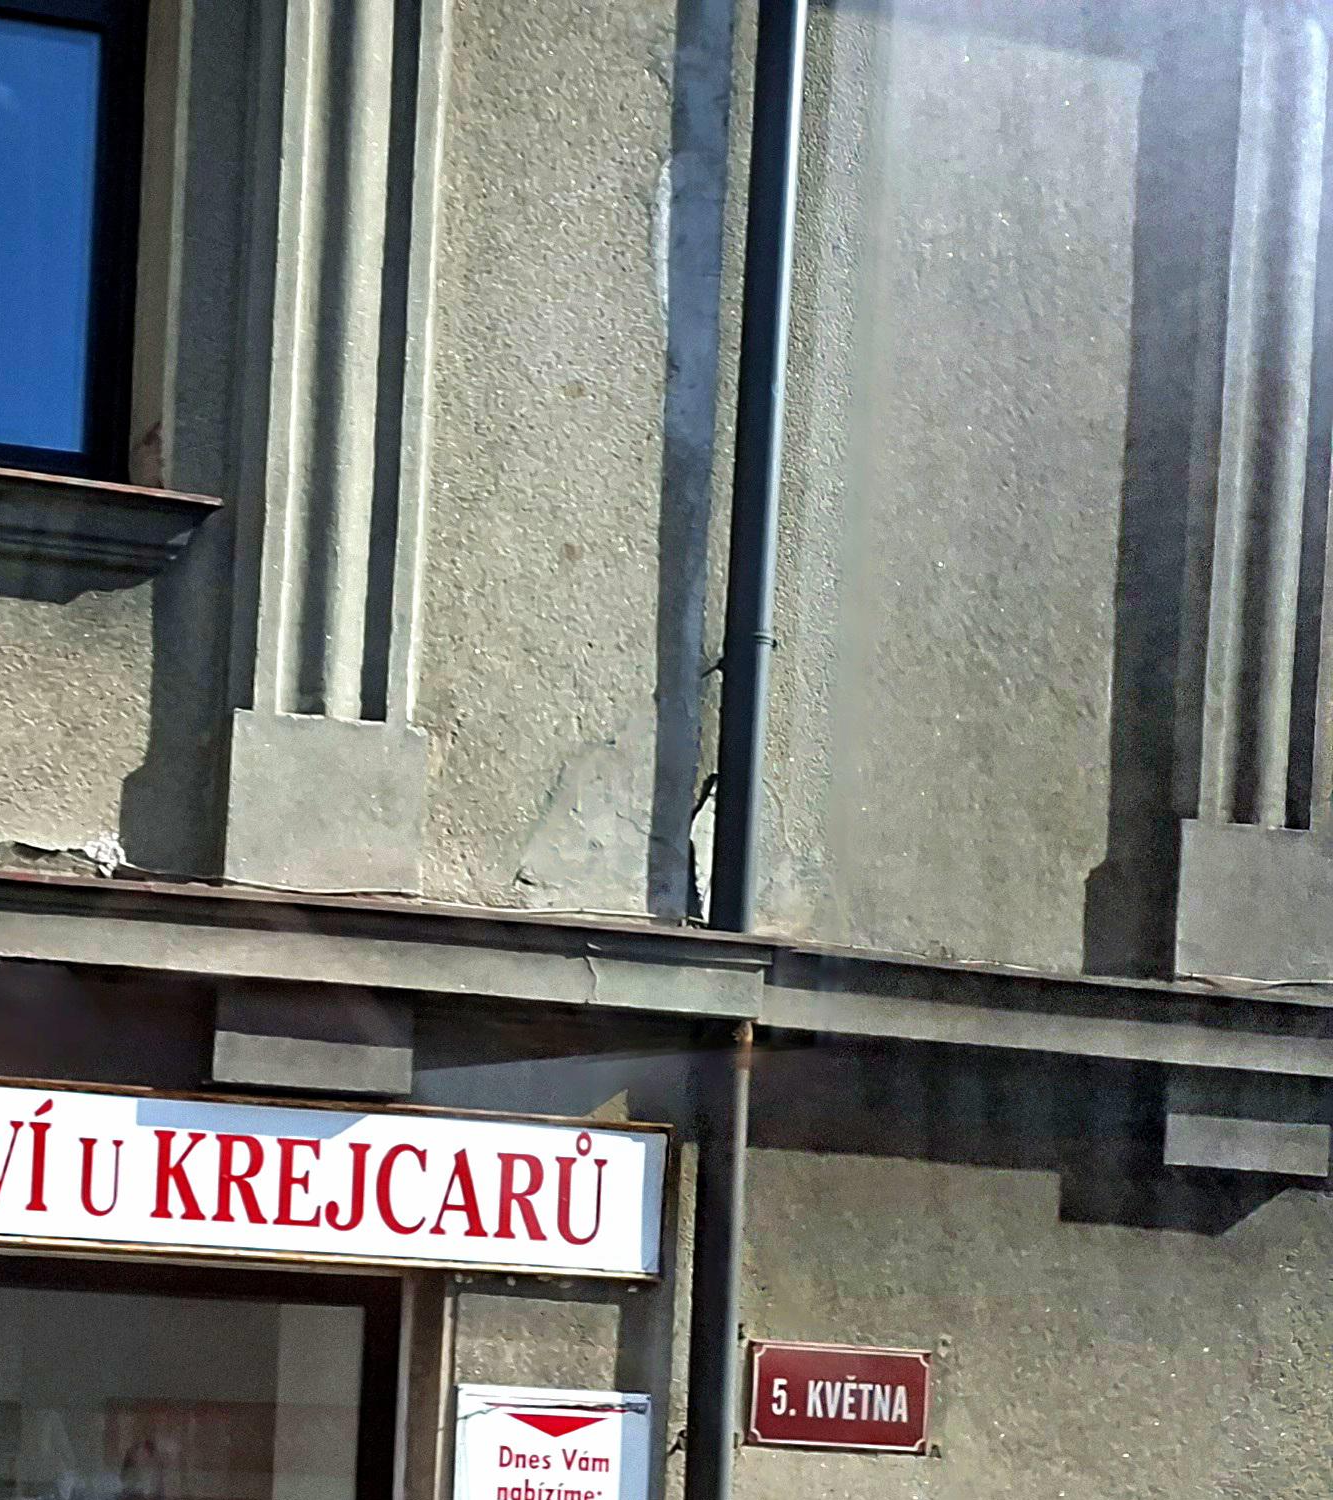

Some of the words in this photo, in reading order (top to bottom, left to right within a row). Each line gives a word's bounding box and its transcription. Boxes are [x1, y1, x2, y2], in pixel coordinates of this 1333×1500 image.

[80, 1137, 124, 1218] U
[150, 1129, 609, 1247] KREJCARŮ
[770, 1376, 797, 1418] 5.
[806, 1374, 909, 1424] KVĚTNA
[498, 1446, 552, 1471] Dnes
[561, 1446, 610, 1474] Vám
